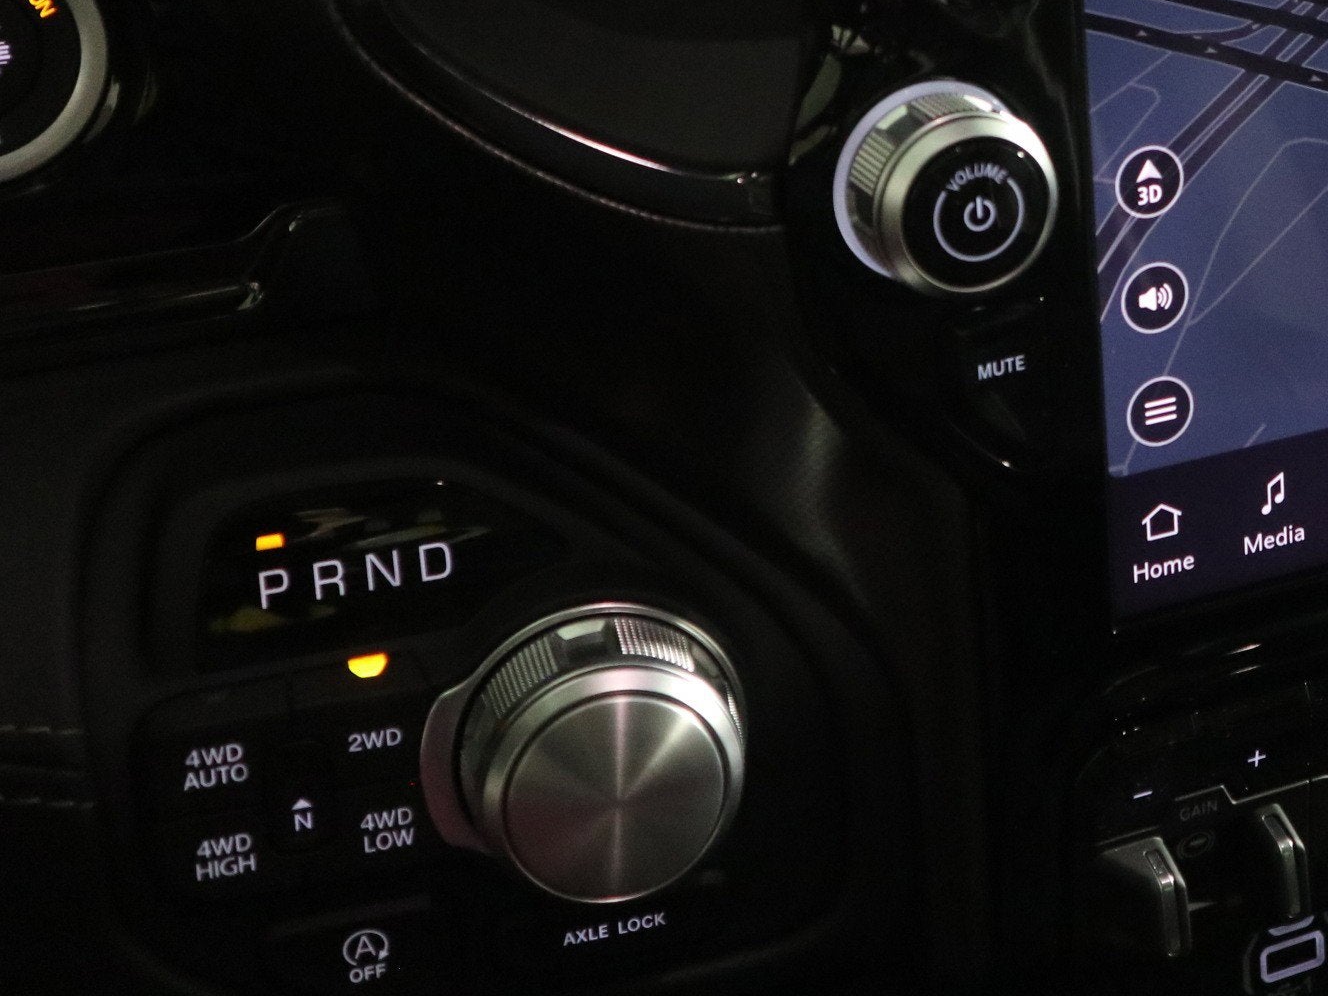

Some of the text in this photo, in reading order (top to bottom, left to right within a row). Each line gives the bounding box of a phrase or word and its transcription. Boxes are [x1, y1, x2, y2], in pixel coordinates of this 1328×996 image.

[946, 162, 1009, 193] VOLUME
[1137, 185, 1162, 206] 3D
[977, 354, 1026, 381] MUTE
[1243, 526, 1306, 556] Media
[258, 542, 453, 610] P R N D
[1132, 555, 1196, 584] Home
[348, 728, 402, 753] 2WD
[186, 743, 243, 768] 4WD
[183, 764, 249, 792] AUTO
[293, 812, 313, 832] N
[360, 808, 413, 833] 4WD
[197, 833, 252, 860] 4WD
[363, 827, 415, 854] LOW
[196, 854, 257, 882] HIGH
[562, 912, 666, 947] AXLE LOCK
[349, 963, 387, 984] OFF
